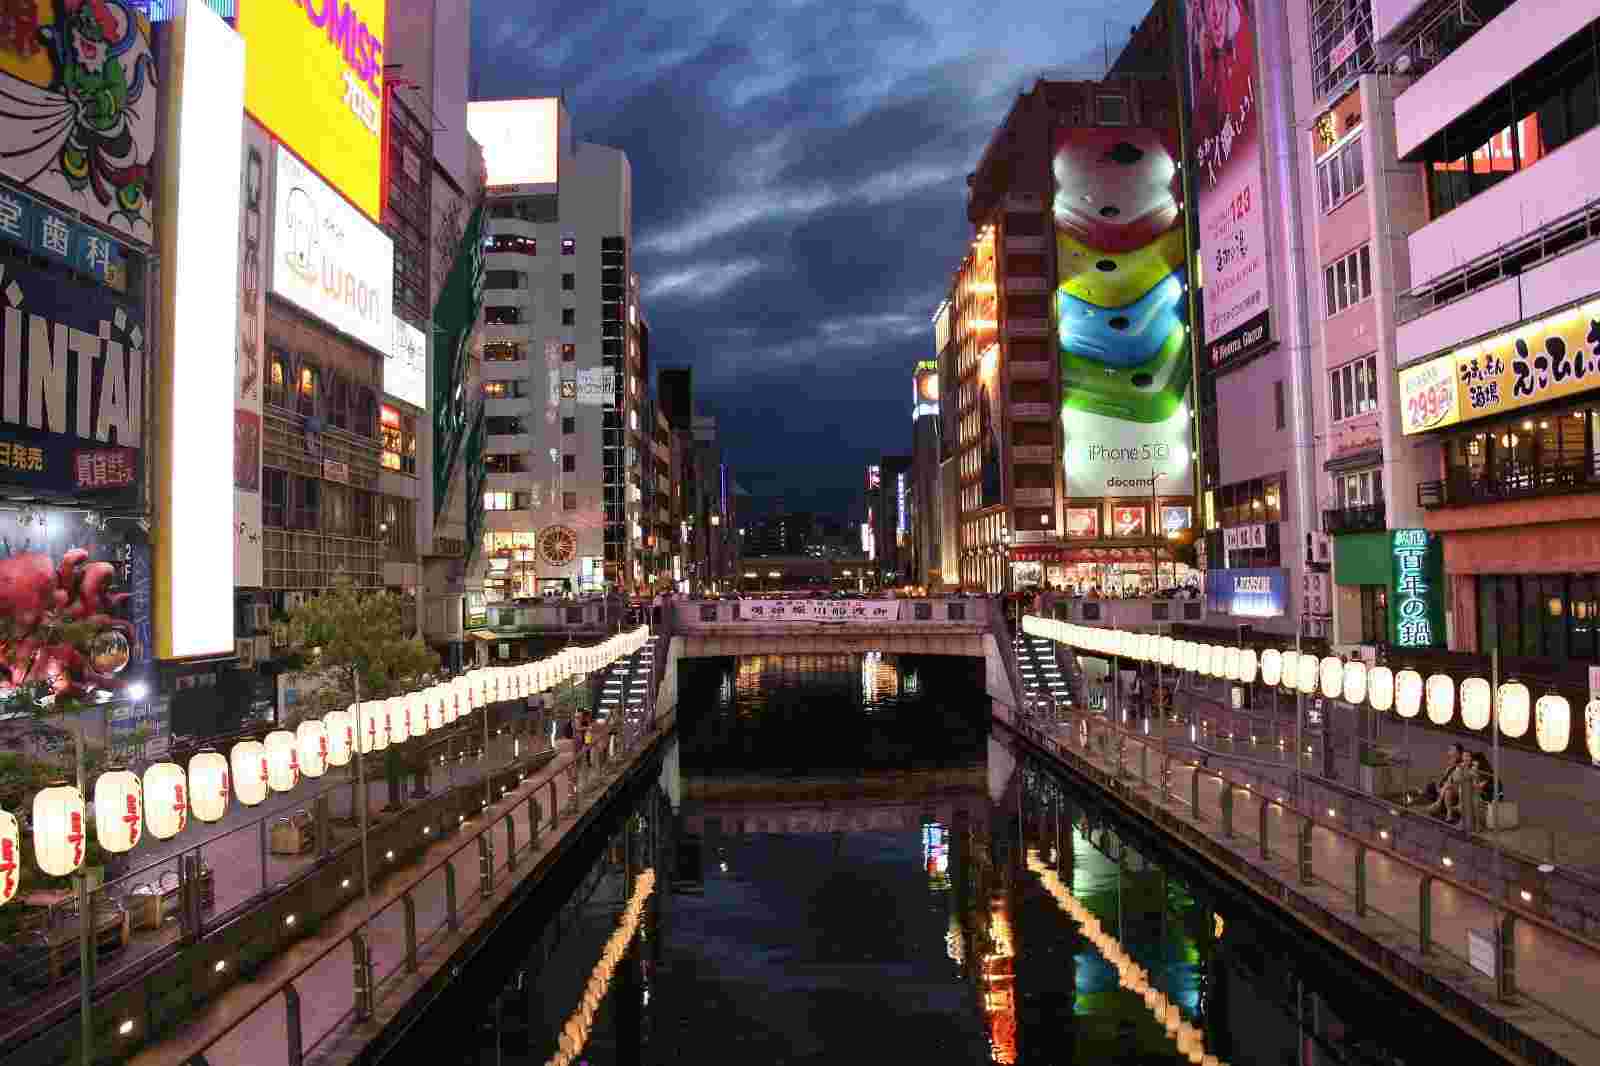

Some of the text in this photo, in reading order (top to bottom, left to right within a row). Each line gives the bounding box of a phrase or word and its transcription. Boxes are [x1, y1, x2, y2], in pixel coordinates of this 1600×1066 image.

[1230, 185, 1251, 224] 123
[1088, 443, 1138, 462] iPhone
[1106, 476, 1153, 488] docomo
